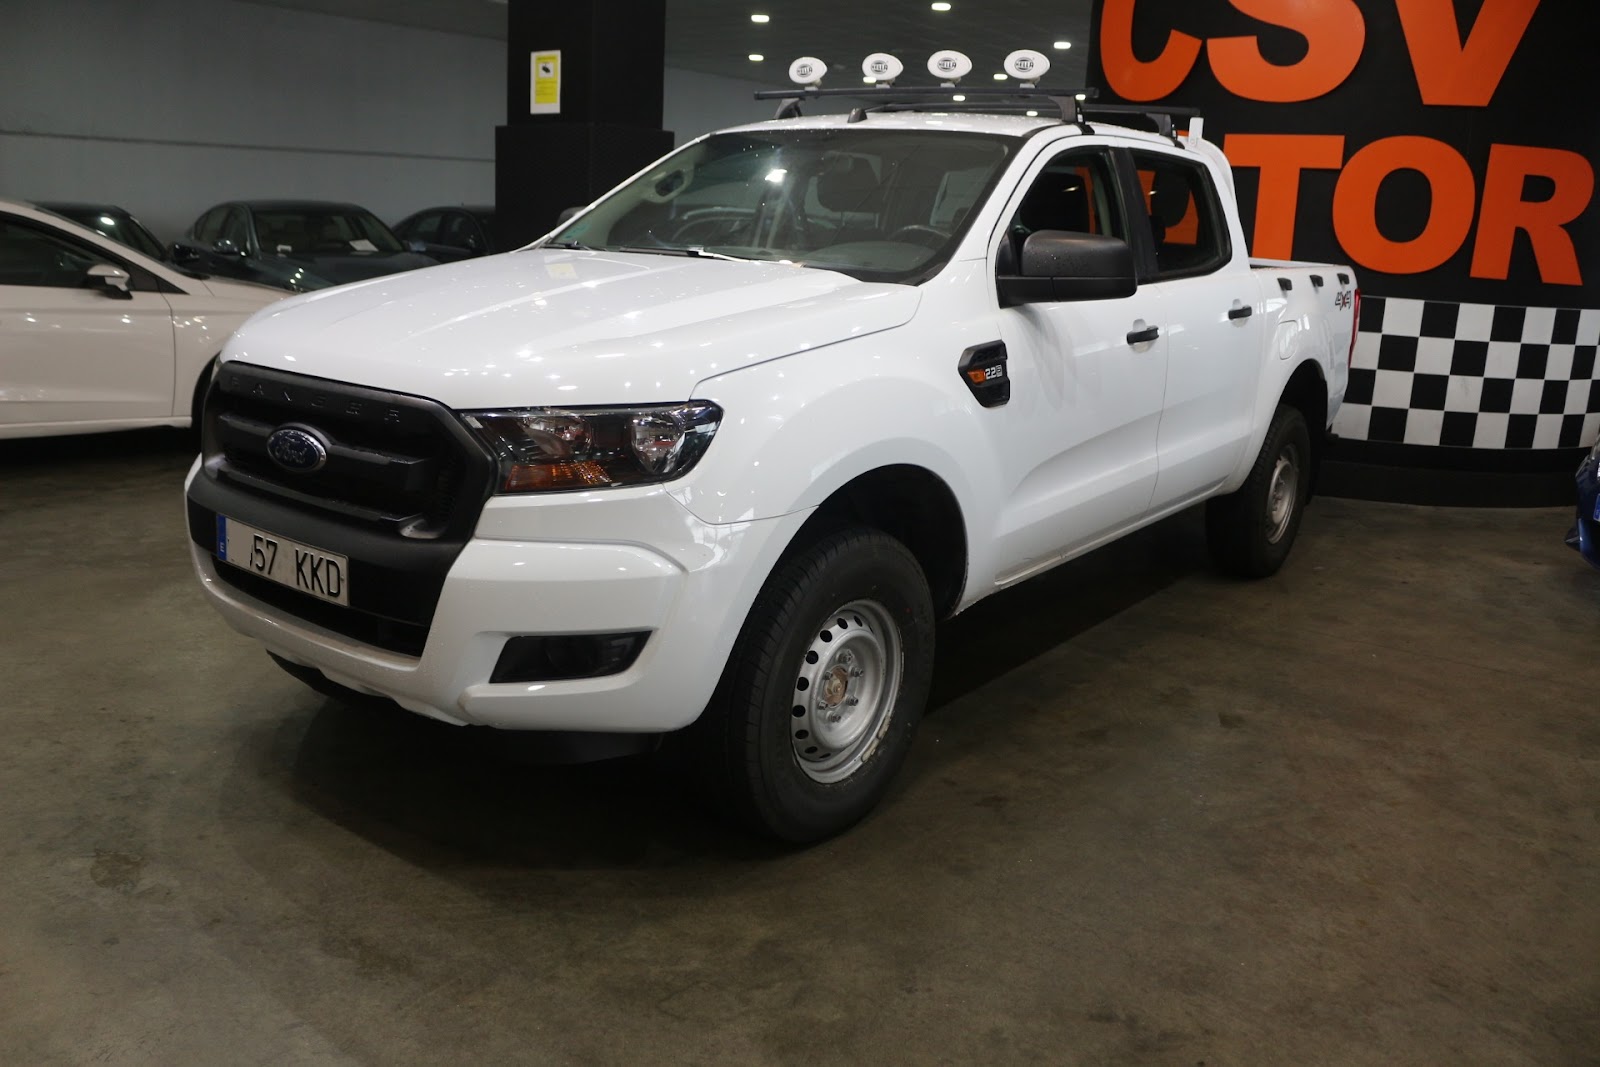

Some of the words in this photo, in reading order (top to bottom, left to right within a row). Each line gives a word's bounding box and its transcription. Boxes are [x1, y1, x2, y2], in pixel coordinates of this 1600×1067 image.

[1100, 0, 1541, 107] CSV
[1165, 131, 1595, 286] TOR
[250, 534, 278, 576] 57
[295, 548, 341, 597] KKD
